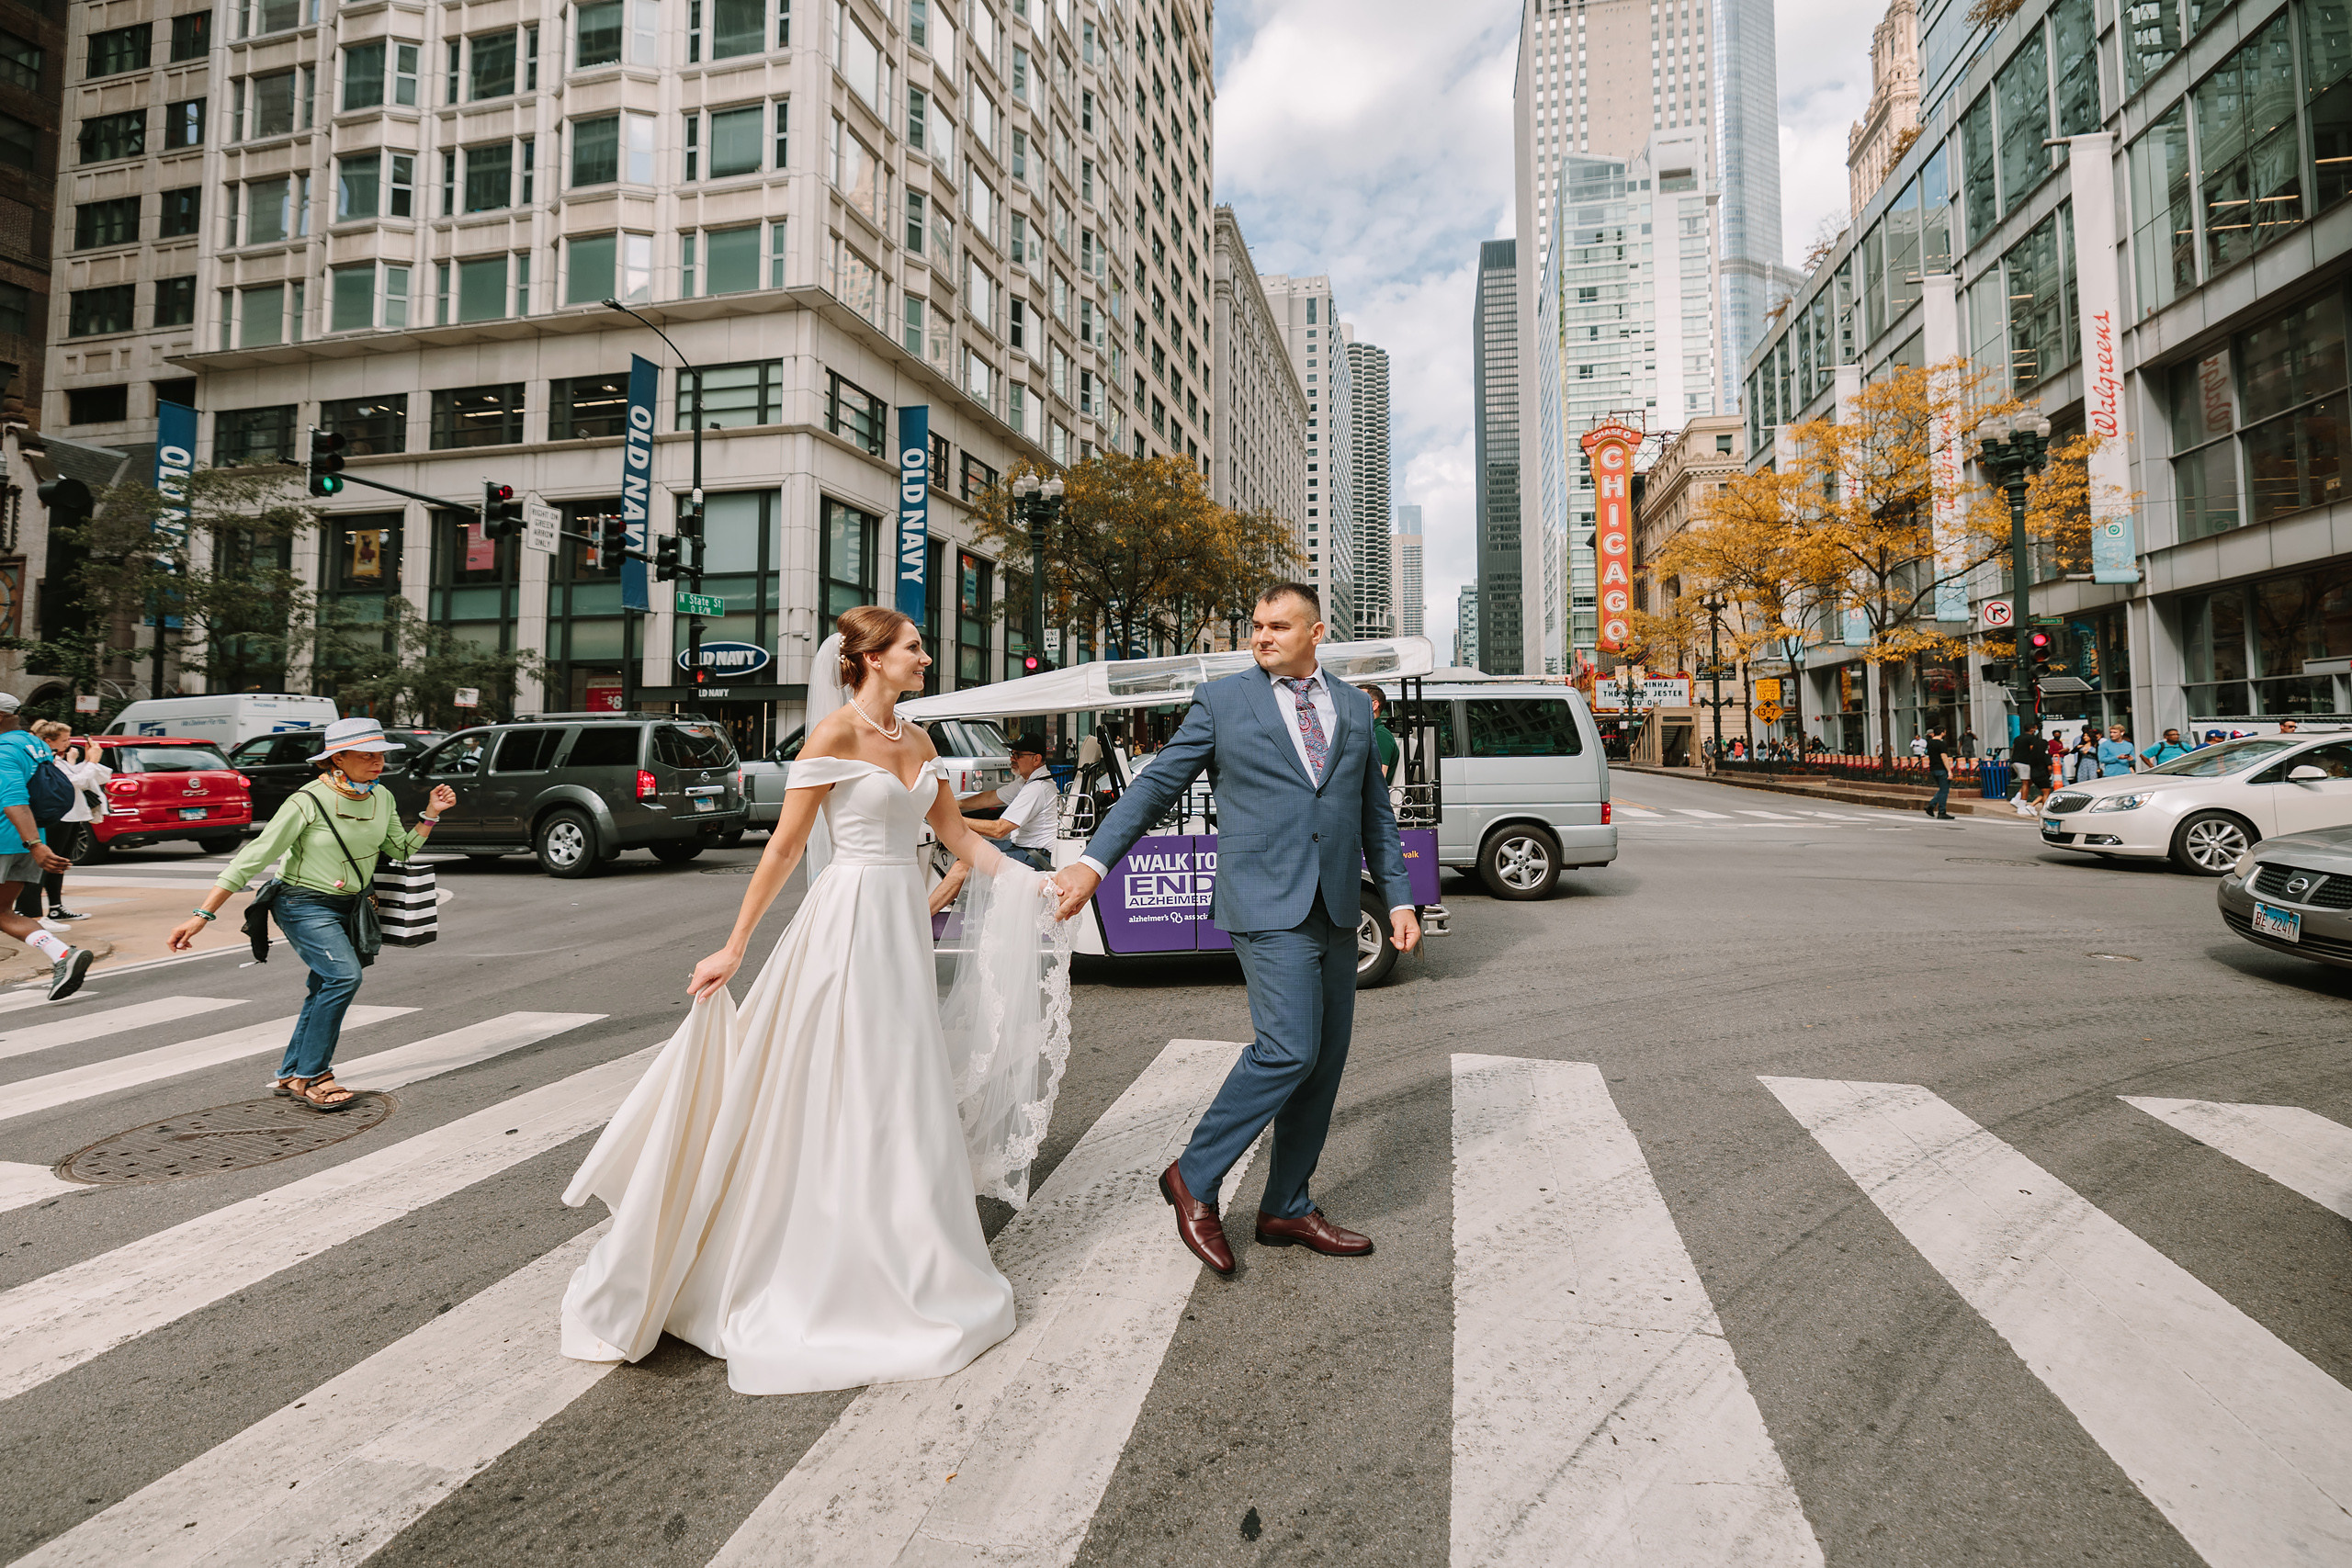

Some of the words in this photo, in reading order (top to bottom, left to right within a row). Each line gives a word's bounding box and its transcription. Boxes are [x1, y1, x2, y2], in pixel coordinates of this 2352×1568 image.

[2090, 310, 2124, 437] Walgreens
[627, 404, 652, 470] OLD
[1592, 428, 1623, 441] CHASE
[901, 447, 926, 504] OLD
[535, 518, 554, 529] GREEN
[900, 509, 925, 584] NAVY
[1600, 446, 1628, 642] CHICAGO
[680, 593, 685, 604] N
[689, 594, 709, 606] State
[713, 598, 722, 609] St
[698, 605, 711, 615] E/W
[716, 650, 757, 665] NAVY
[708, 689, 729, 697] NAVY
[1127, 852, 1189, 872] WALK
[1192, 852, 1217, 870] TO
[1129, 874, 1216, 896] END
[1129, 895, 1212, 907] ALZHEIMER'
[1128, 914, 1170, 922] alzheimer's
[2256, 911, 2267, 927] BE
[2271, 916, 2297, 936] 22477
